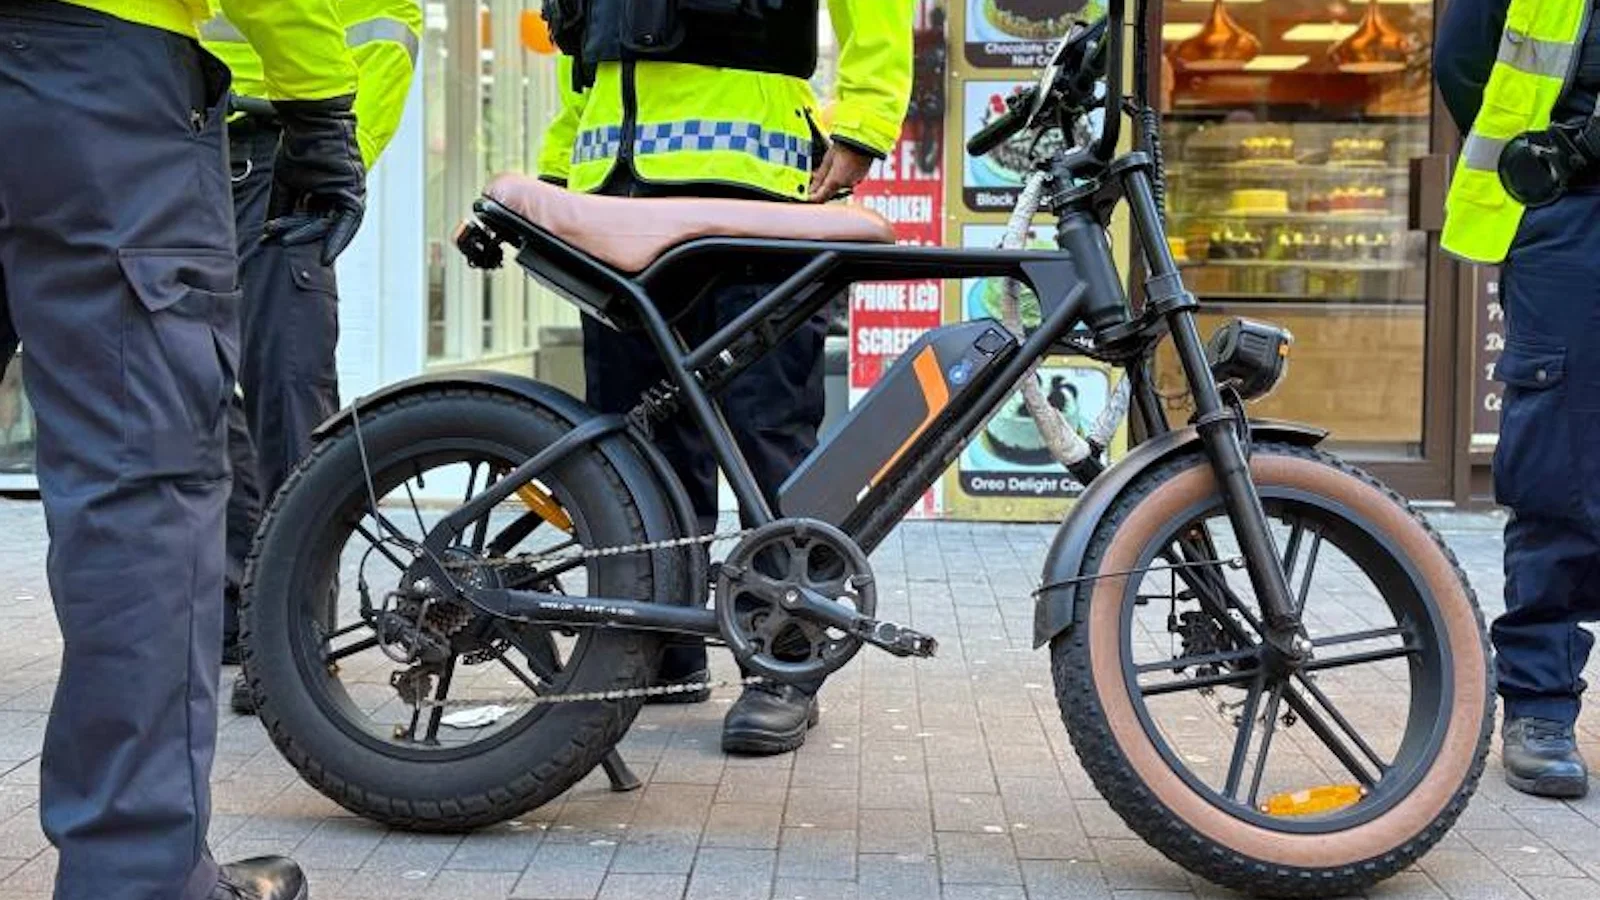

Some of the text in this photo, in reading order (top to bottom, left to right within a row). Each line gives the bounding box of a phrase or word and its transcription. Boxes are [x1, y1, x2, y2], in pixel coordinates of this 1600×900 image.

[985, 42, 1044, 55] Chocolate
[1011, 54, 1034, 66] Nut
[976, 193, 1015, 207] Black
[855, 283, 939, 312] PHONE LCD
[971, 477, 1006, 491] Oreo
[1008, 477, 1058, 494] Delight
